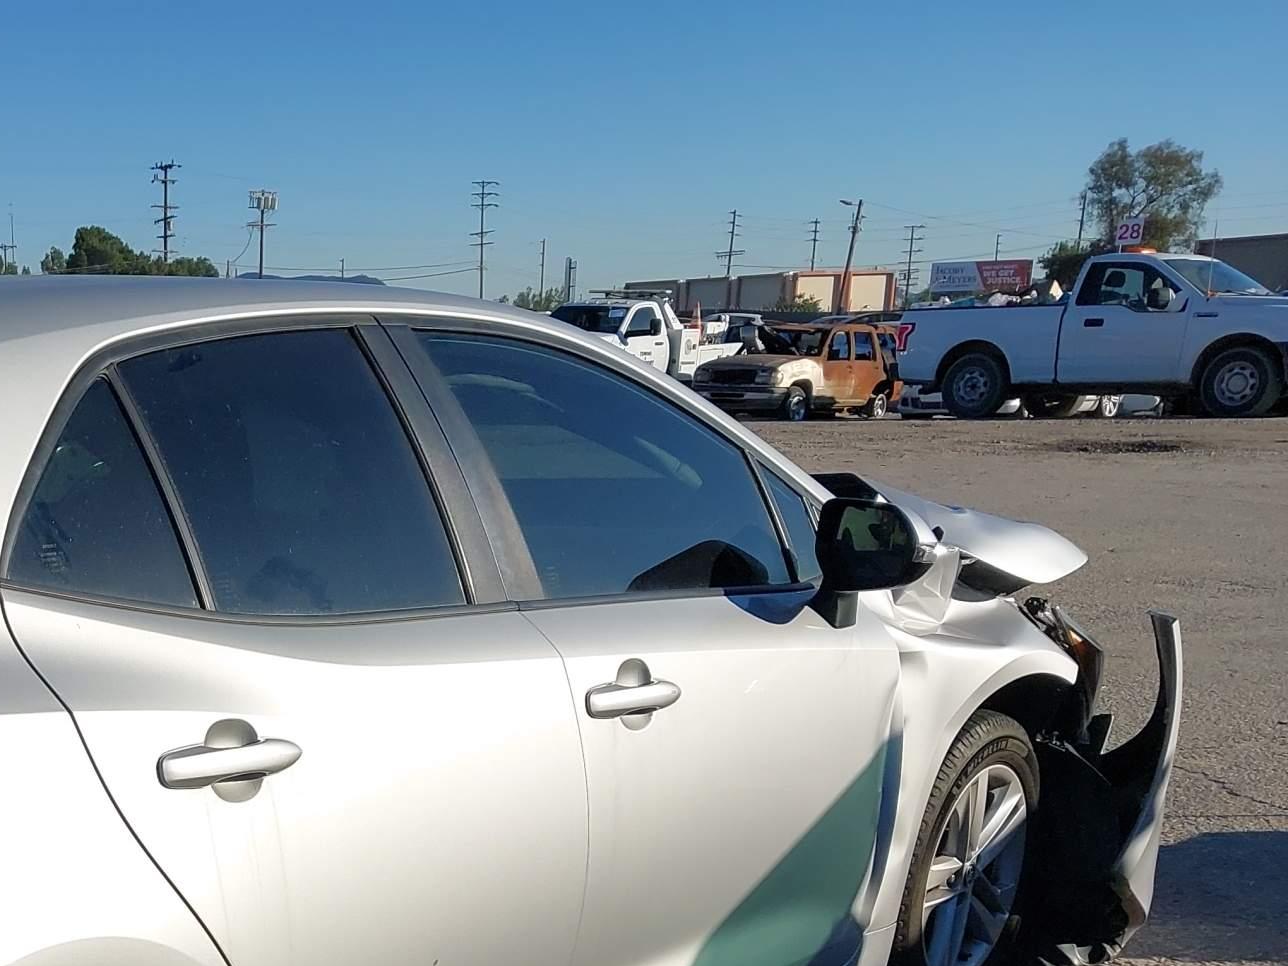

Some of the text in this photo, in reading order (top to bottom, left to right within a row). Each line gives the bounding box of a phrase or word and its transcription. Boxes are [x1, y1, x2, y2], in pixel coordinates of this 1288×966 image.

[1118, 223, 1141, 240] 28
[936, 265, 964, 274] JACOBY
[998, 269, 1015, 277] GET
[944, 274, 975, 284] MEYERS
